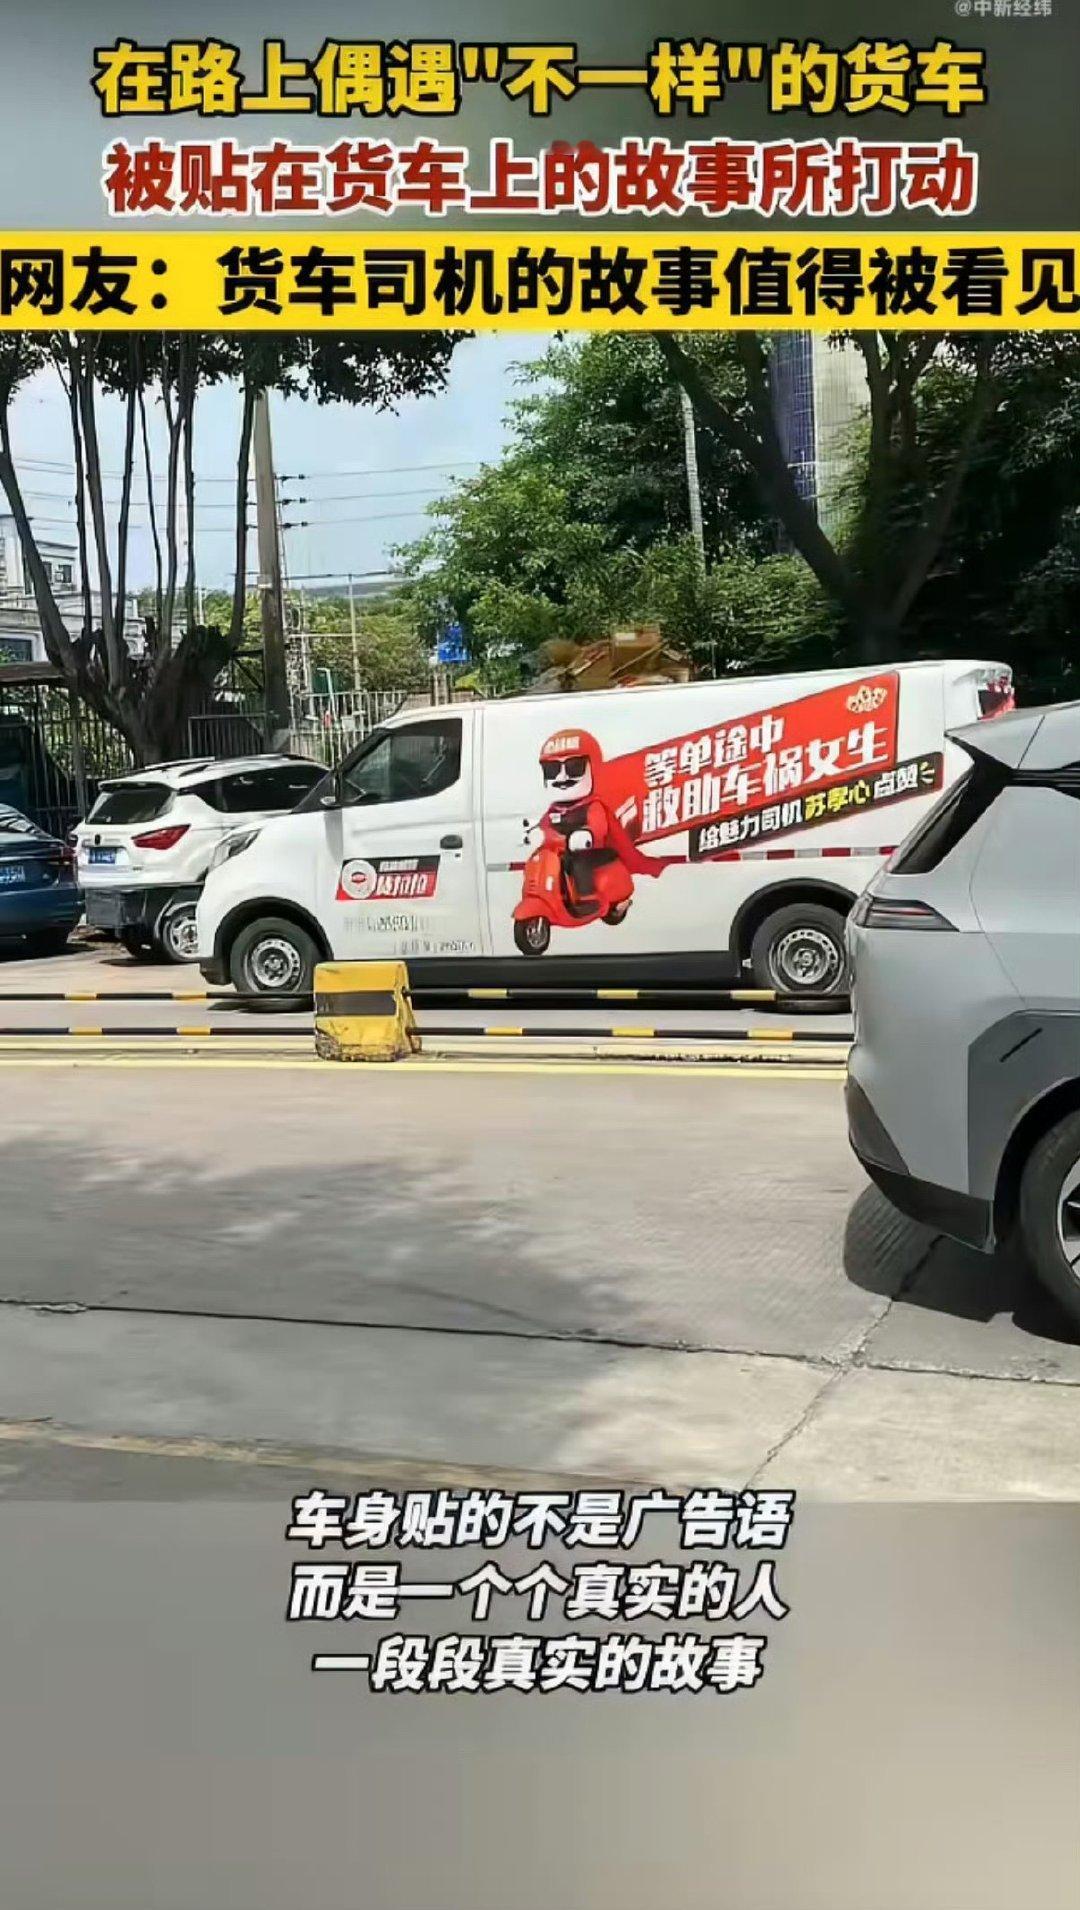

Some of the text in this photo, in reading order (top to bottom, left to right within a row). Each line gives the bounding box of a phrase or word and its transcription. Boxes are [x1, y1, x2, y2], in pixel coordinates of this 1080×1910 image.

[642, 721, 889, 834] 救助车祸女生
[645, 714, 785, 788] 等单途中
